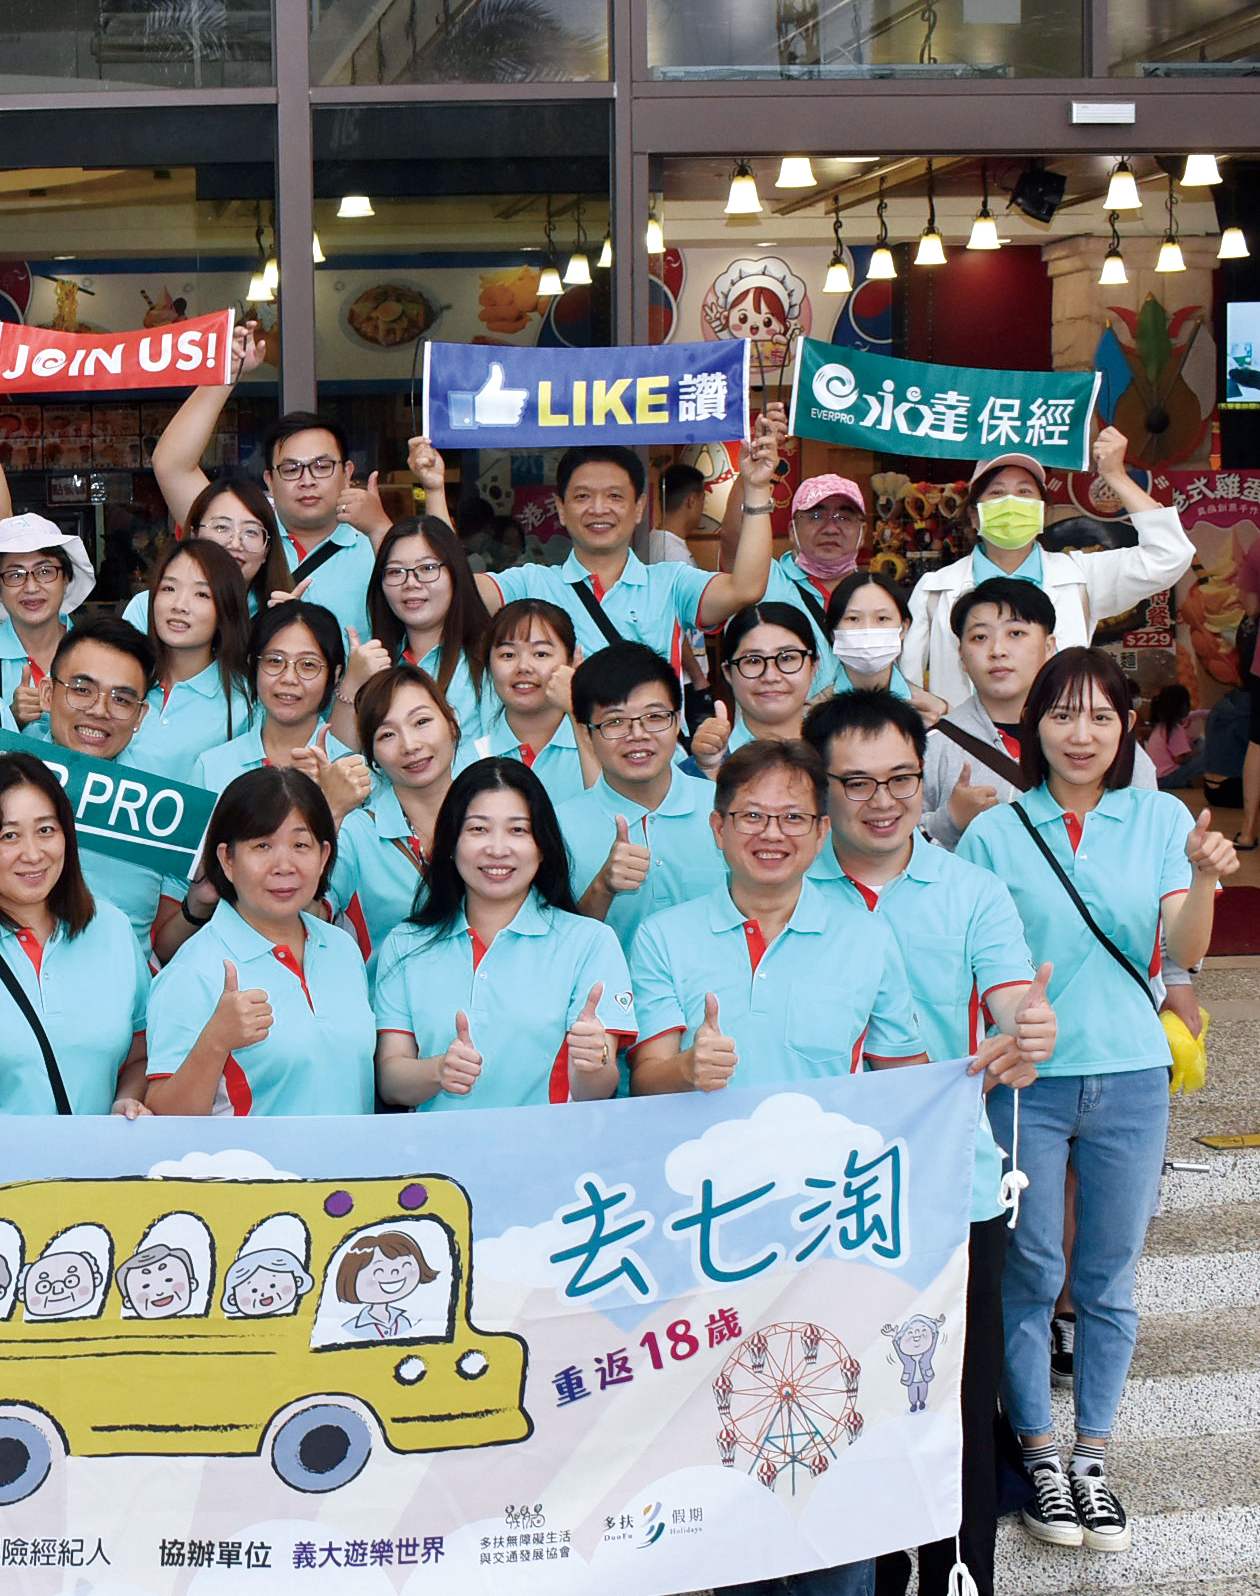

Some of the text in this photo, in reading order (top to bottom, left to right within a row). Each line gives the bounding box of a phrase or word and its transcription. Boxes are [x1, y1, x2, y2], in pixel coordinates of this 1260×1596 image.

[2, 331, 218, 380] JOIN US!
[538, 375, 670, 427] LIKE
[678, 371, 728, 422] 讚
[810, 407, 855, 425] EVERPRO
[859, 379, 1076, 447] 永達保經
[1126, 633, 1171, 646] $229
[76, 771, 185, 837] PRO
[549, 1146, 901, 1297] 去七淘
[552, 1307, 742, 1408] 重返18歲
[603, 1515, 634, 1532] 多扶
[672, 1507, 703, 1524] 假期
[480, 1530, 572, 1550] 多扶無障礙生活
[604, 1533, 633, 1542] DuoFu
[670, 1527, 703, 1536] Holidays
[159, 1538, 273, 1569] 協辦單位
[292, 1536, 446, 1569] 義大遊樂世界
[480, 1545, 571, 1565] 與交通發展協會
